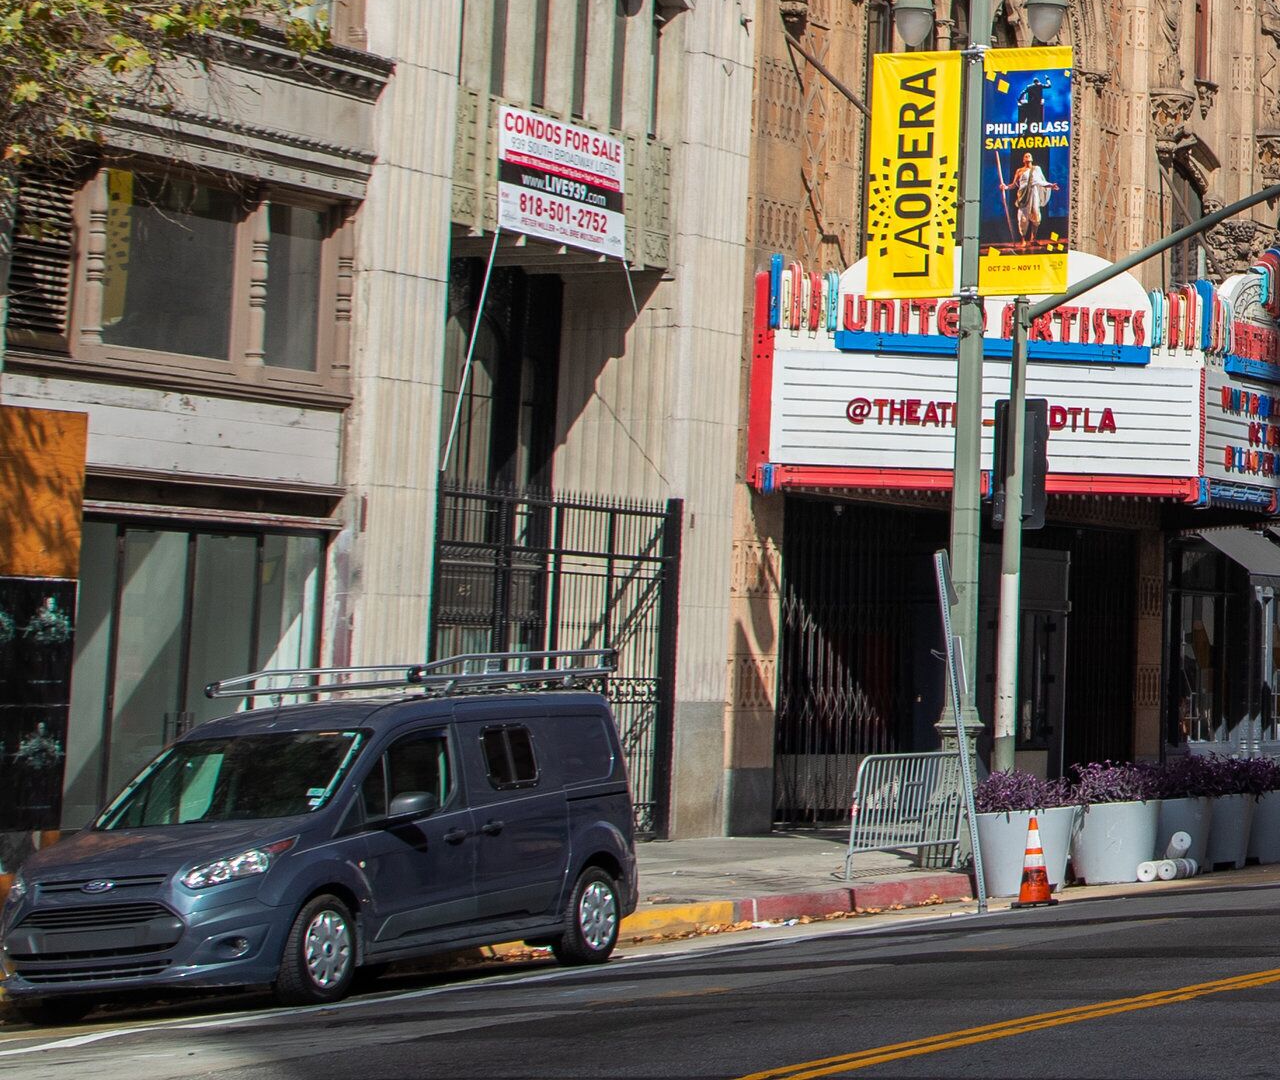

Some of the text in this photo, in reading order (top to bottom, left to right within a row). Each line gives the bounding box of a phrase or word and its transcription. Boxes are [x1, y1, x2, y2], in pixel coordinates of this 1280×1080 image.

[504, 112, 621, 163] CONDOS FOR SALE
[985, 136, 1069, 150] SATYAGRAHA
[986, 121, 1069, 135] PHILIP GLASS
[512, 136, 525, 150] 939
[528, 140, 552, 157] SOUTH
[554, 147, 594, 169] BROADWAY
[519, 193, 607, 233] 818-501-2752
[842, 294, 987, 337] UNITE
